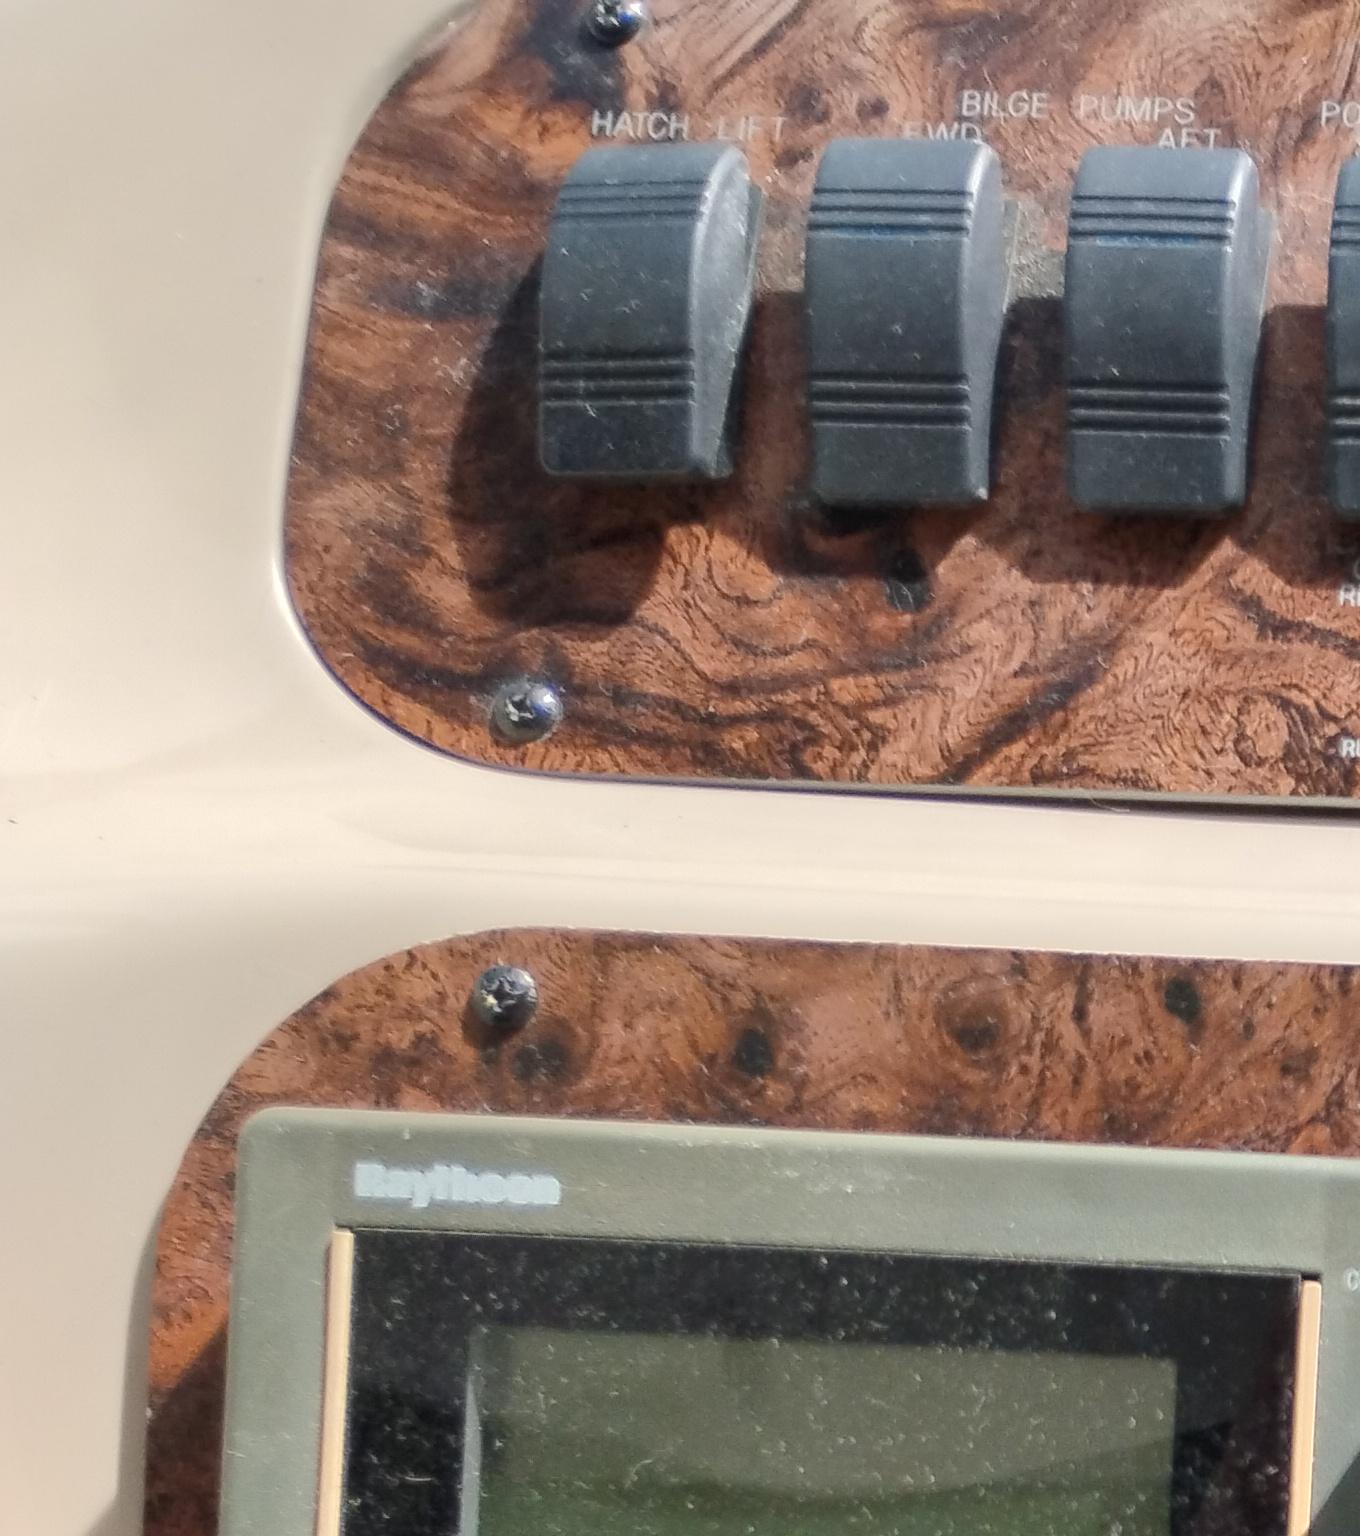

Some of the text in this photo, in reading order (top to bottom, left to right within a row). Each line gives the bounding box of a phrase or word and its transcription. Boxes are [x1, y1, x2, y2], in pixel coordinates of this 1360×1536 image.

[960, 89, 1197, 124] BILGE PUMPS
[591, 110, 787, 142] HATCH LIFT
